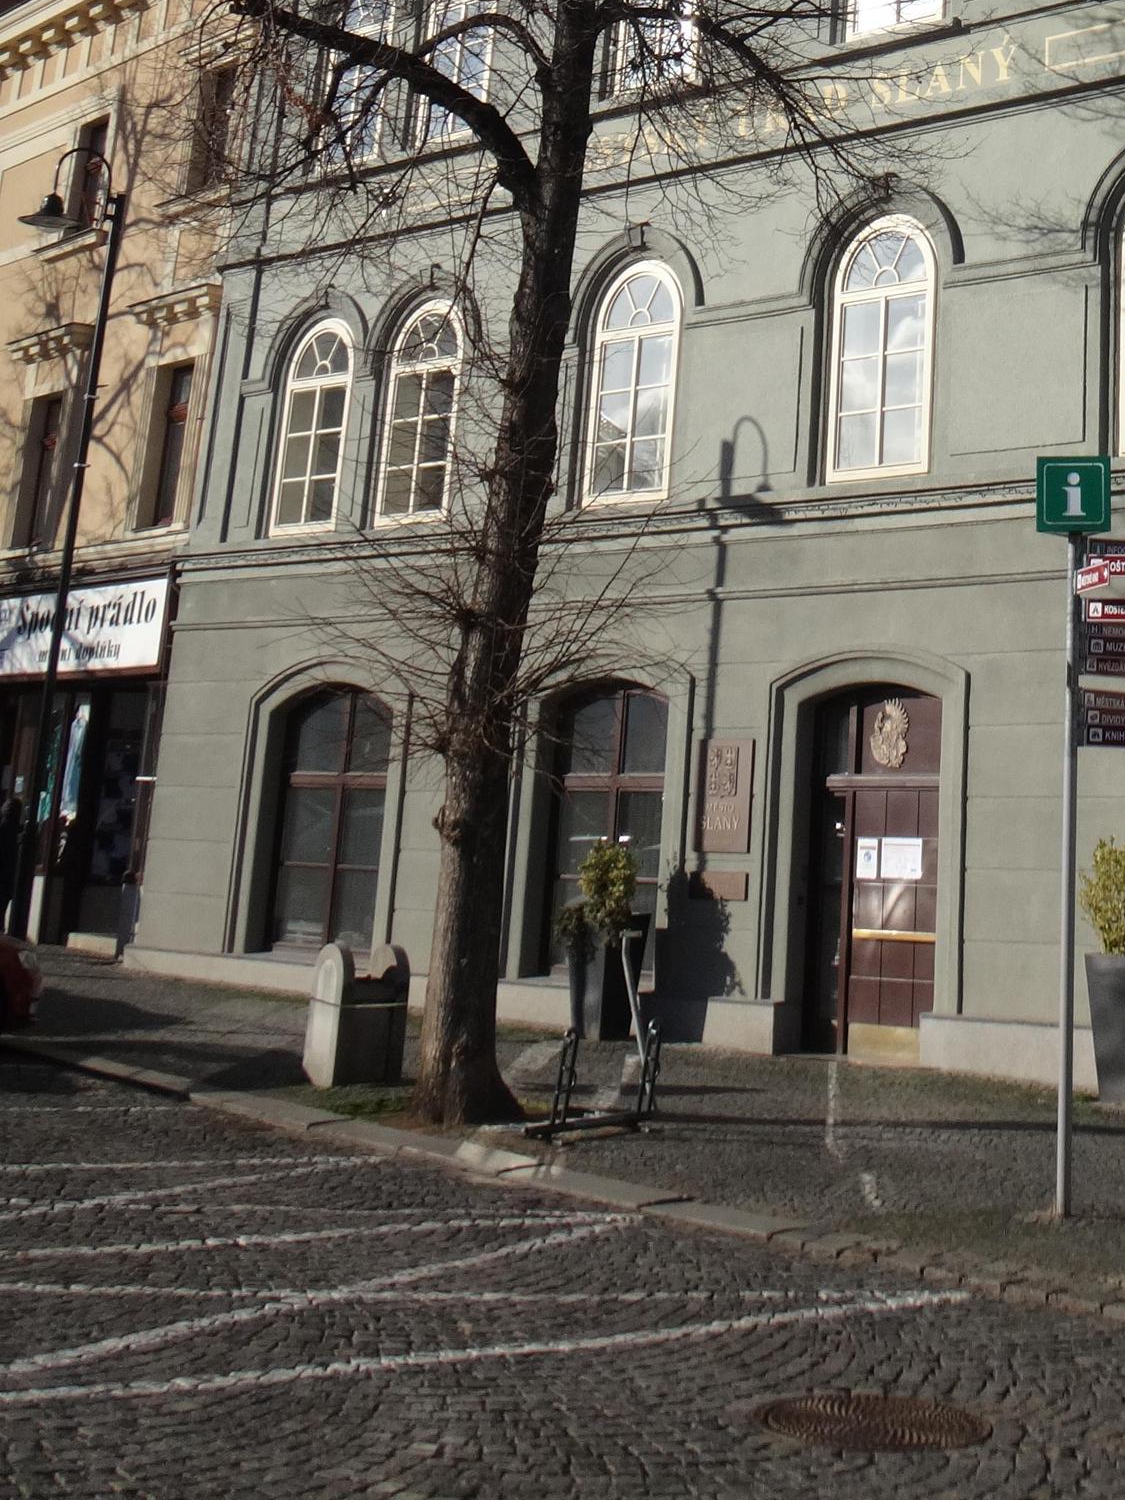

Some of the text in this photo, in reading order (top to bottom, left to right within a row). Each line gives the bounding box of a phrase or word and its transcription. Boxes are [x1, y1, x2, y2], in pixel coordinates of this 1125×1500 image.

[870, 34, 1018, 110] SLANÝ
[17, 590, 158, 640] Sponí prádlo
